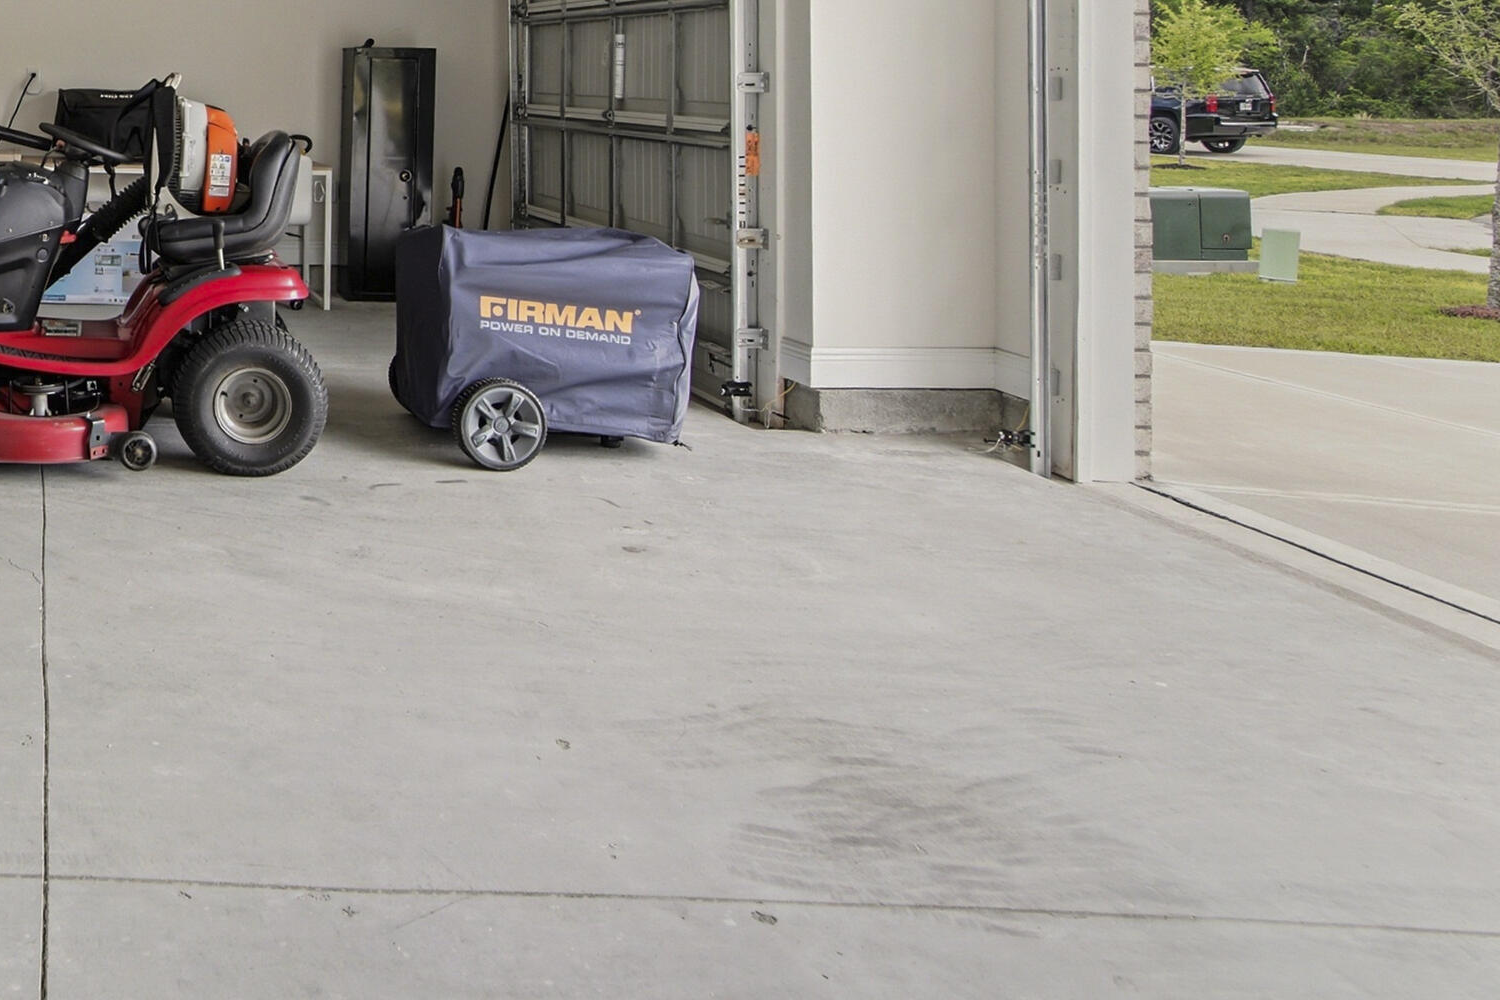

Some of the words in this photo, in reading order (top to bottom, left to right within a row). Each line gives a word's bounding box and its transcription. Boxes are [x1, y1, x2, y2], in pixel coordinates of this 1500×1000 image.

[480, 296, 633, 334] FIRMAN
[480, 320, 533, 334] POWER
[538, 326, 561, 337] ON
[565, 329, 631, 345] DEMAND
